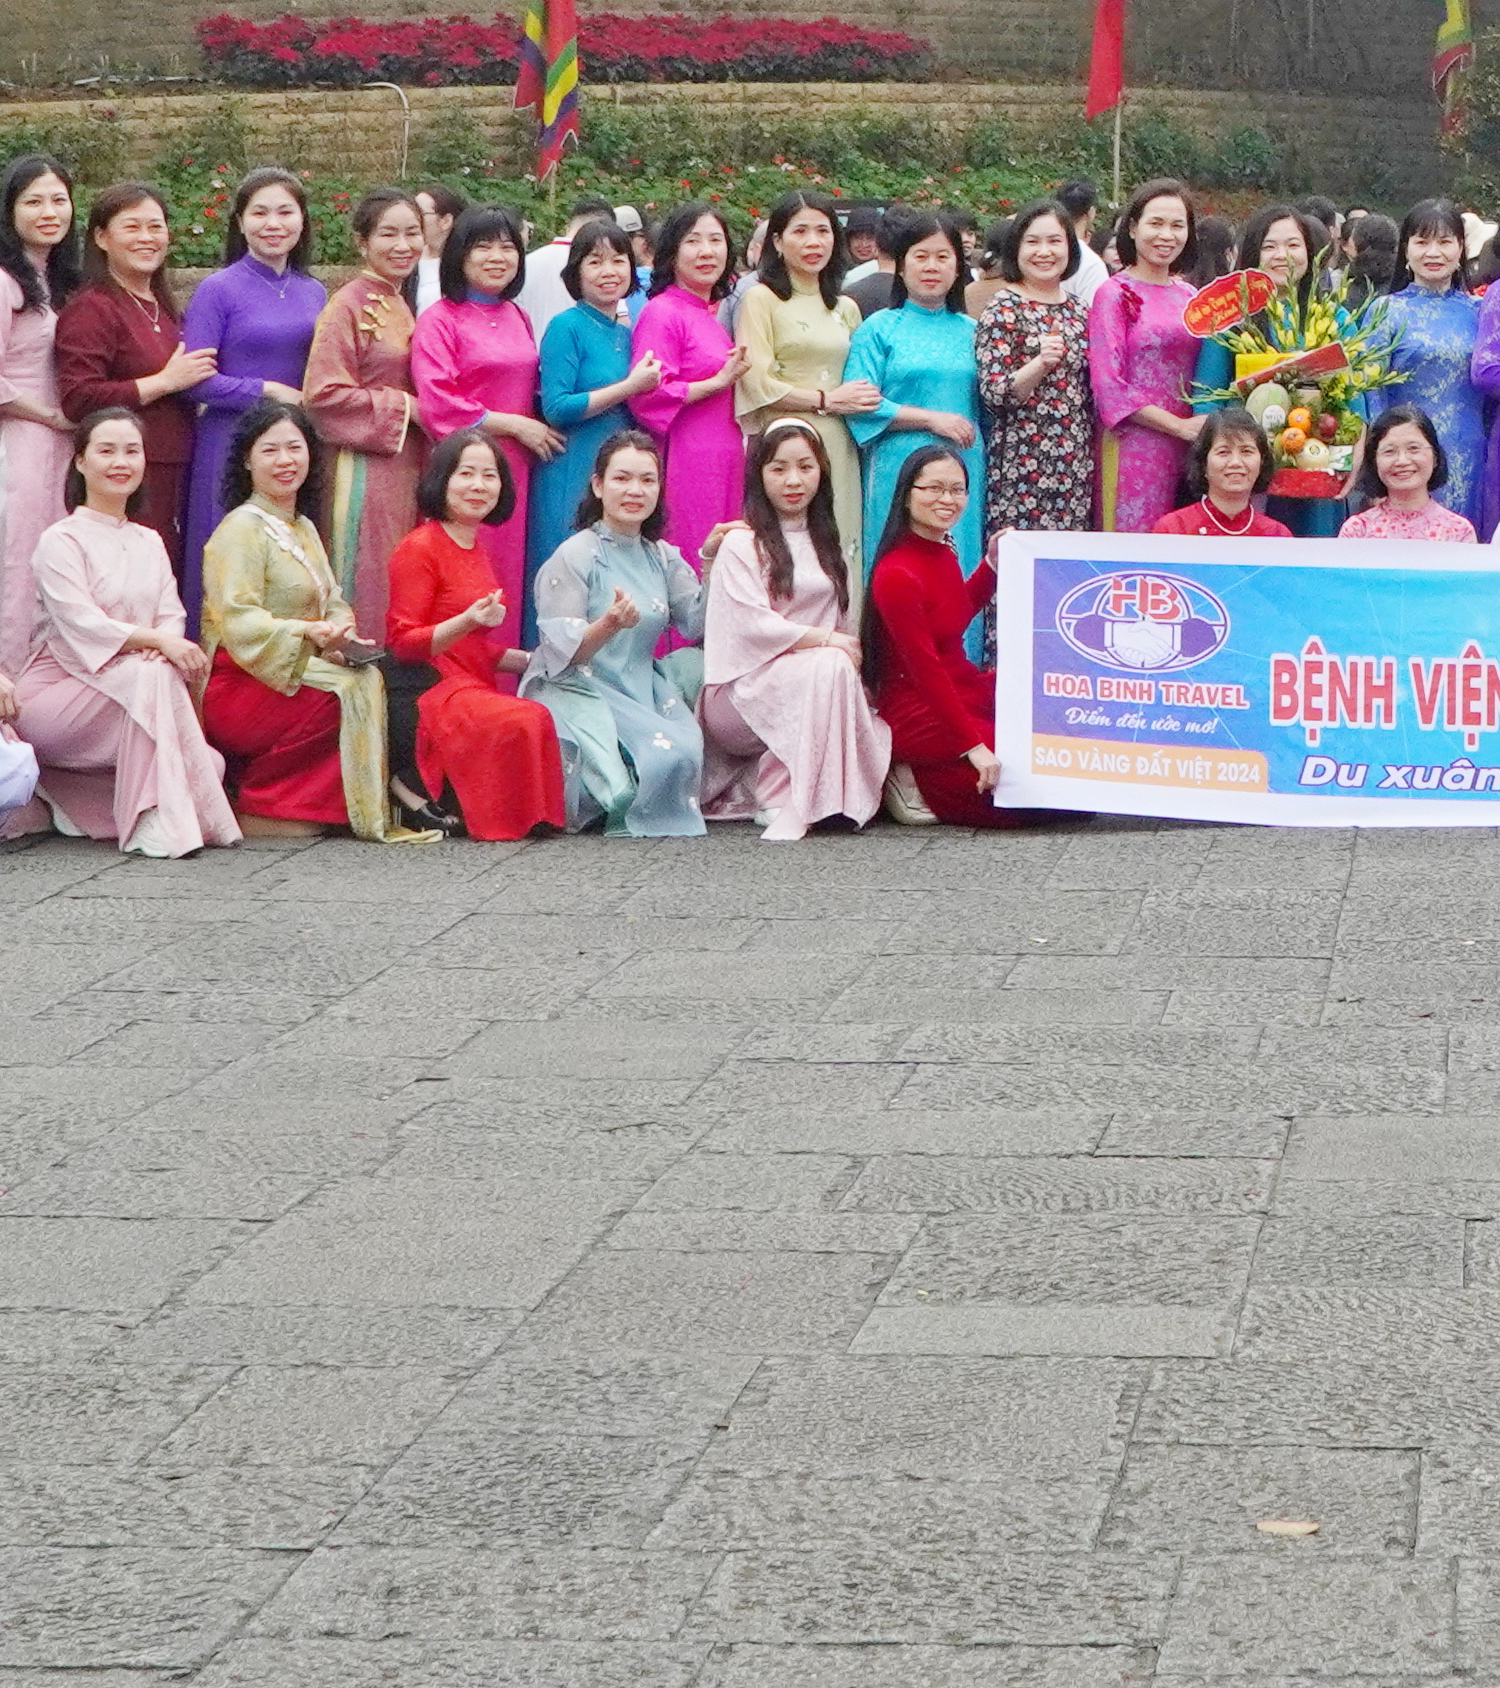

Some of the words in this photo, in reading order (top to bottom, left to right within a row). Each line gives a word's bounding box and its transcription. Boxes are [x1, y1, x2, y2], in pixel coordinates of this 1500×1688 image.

[1107, 575, 1183, 621] HB
[1044, 672, 1093, 699] HOA
[1097, 676, 1155, 704] BINH
[1159, 680, 1250, 709] TRAVEL
[1269, 634, 1397, 748] BỆNH
[1065, 706, 1112, 727] Điểm
[1116, 711, 1147, 730] đến
[1034, 747, 1072, 768] SAO
[1077, 747, 1130, 773] VÀNG
[1136, 748, 1171, 779] ĐẤT
[1177, 756, 1212, 785] VIỆT
[1217, 763, 1261, 784] 2024
[1298, 755, 1368, 789] Du
